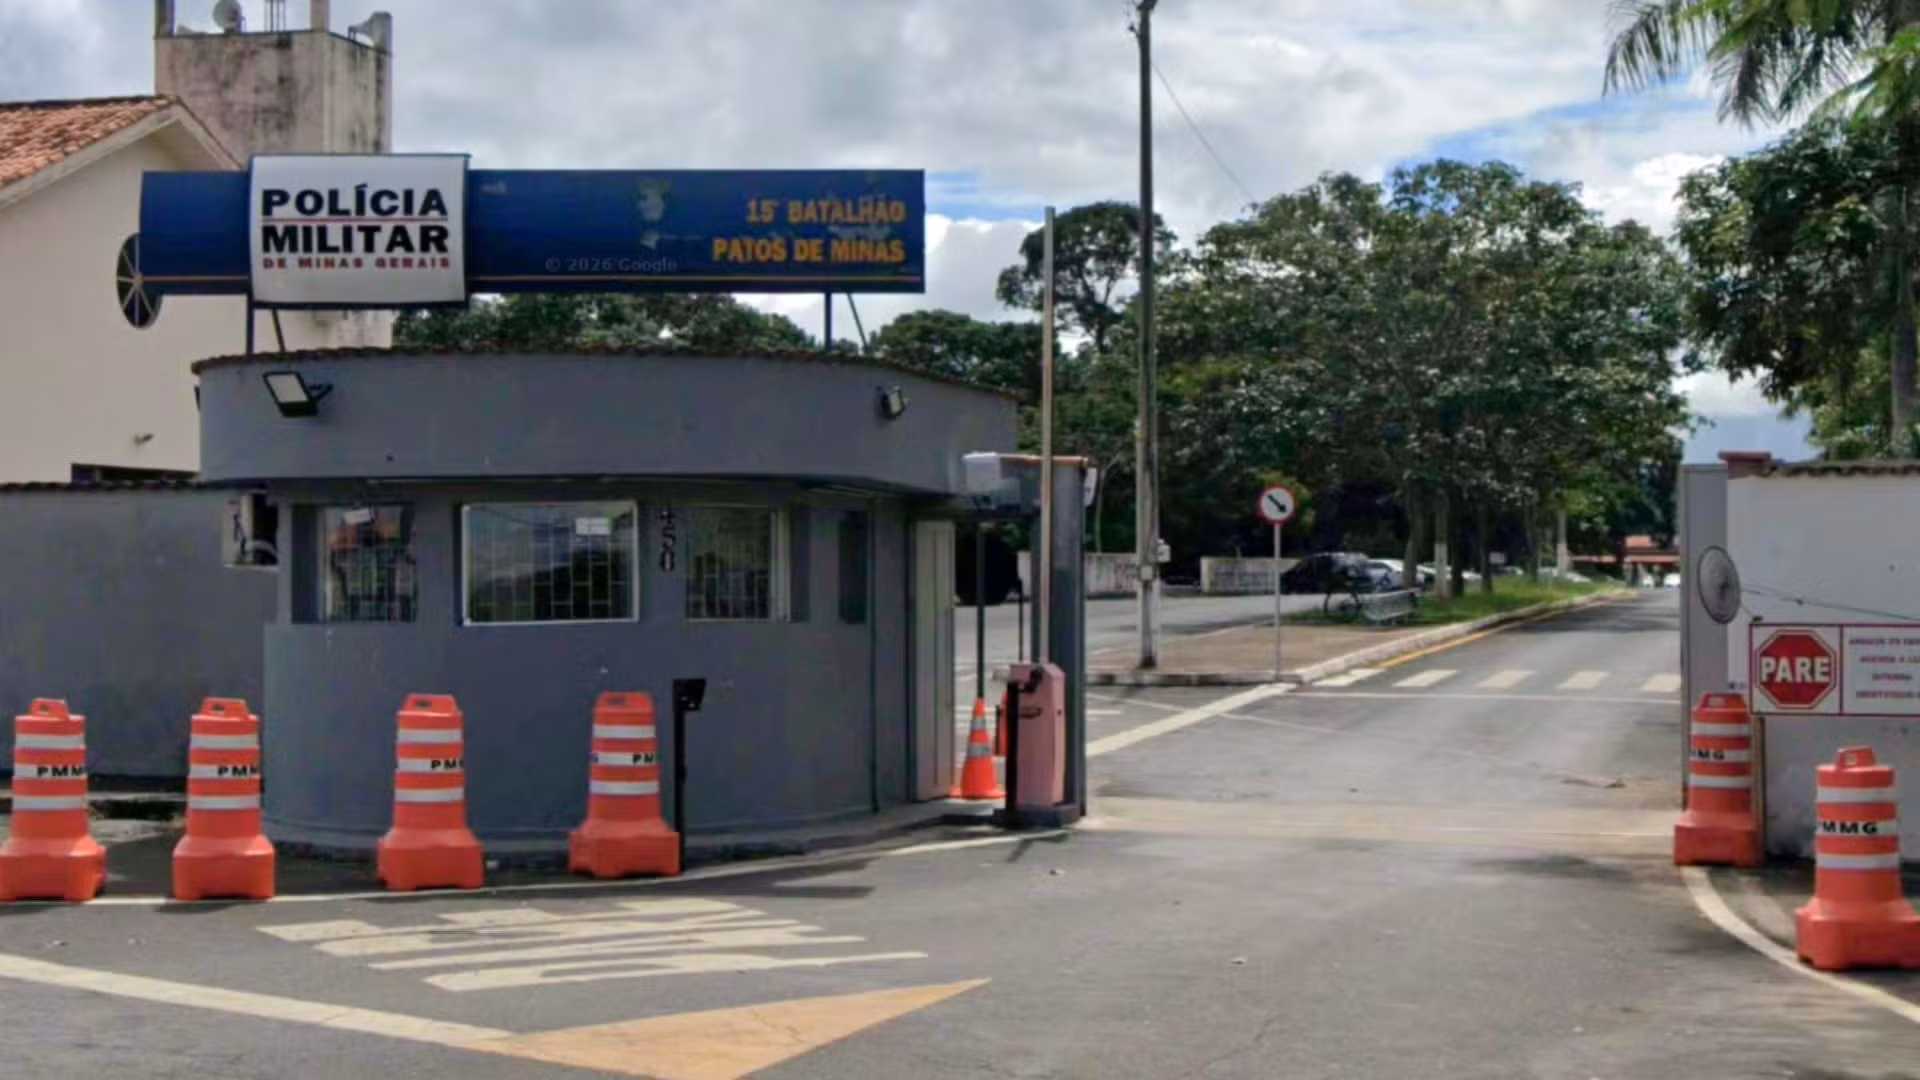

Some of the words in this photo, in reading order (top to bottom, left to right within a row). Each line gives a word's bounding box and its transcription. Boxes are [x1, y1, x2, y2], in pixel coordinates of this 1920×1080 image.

[262, 183, 448, 216] POLÍCIA
[787, 195, 906, 224] BATALHÃO
[262, 225, 450, 254] MILITAR
[712, 238, 787, 263] PATOS
[794, 238, 825, 263] DE
[831, 238, 906, 263] MINAS
[262, 258, 287, 269] DE
[298, 258, 364, 269] MINAS
[375, 258, 450, 269] GERAIS
[1760, 655, 1830, 683] PARE
